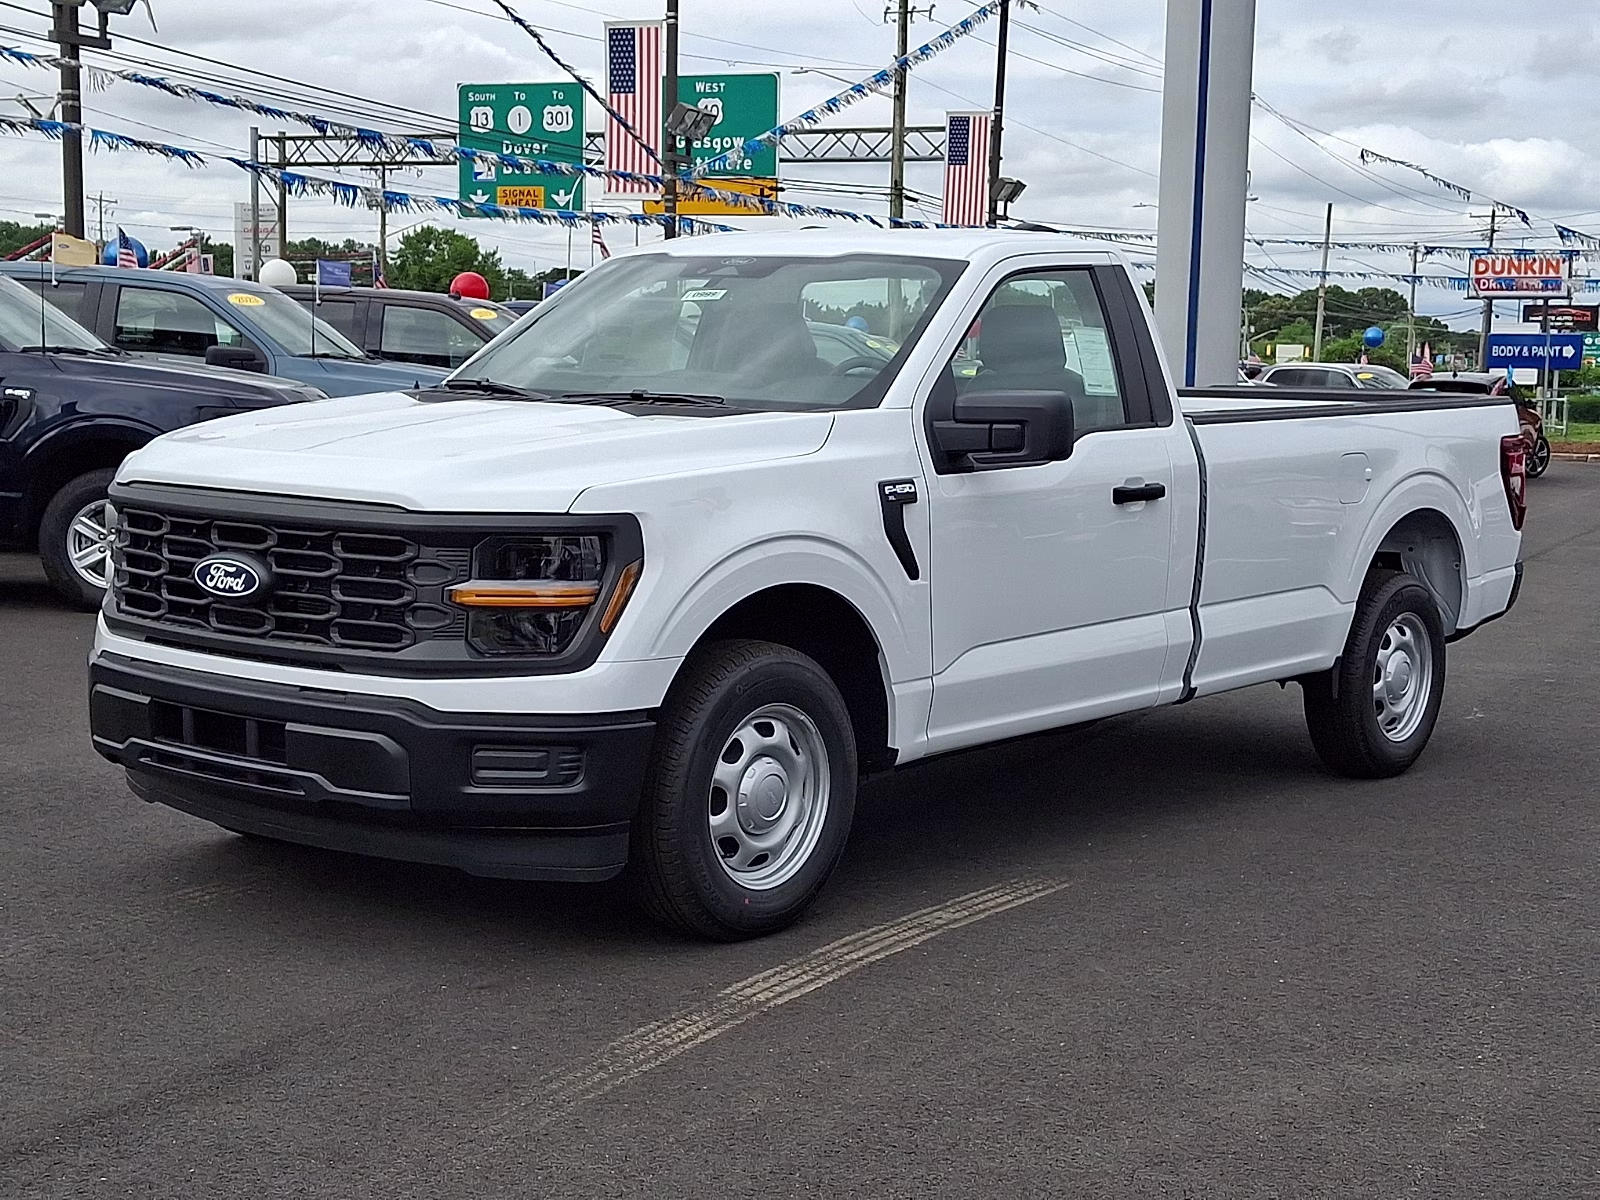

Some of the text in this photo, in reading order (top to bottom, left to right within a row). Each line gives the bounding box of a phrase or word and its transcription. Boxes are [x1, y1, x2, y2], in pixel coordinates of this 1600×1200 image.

[695, 81, 726, 93] WEST
[467, 91, 497, 102] SOUTH
[475, 110, 570, 127] 13 1 301
[502, 140, 549, 155] Dover
[674, 135, 745, 154] Gasgow
[501, 188, 539, 199] SIGNAL
[503, 198, 539, 208] AHEAD
[1491, 345, 1562, 358] BODY & PAINT
[884, 483, 916, 495] F-150
[205, 563, 247, 592] Ford
